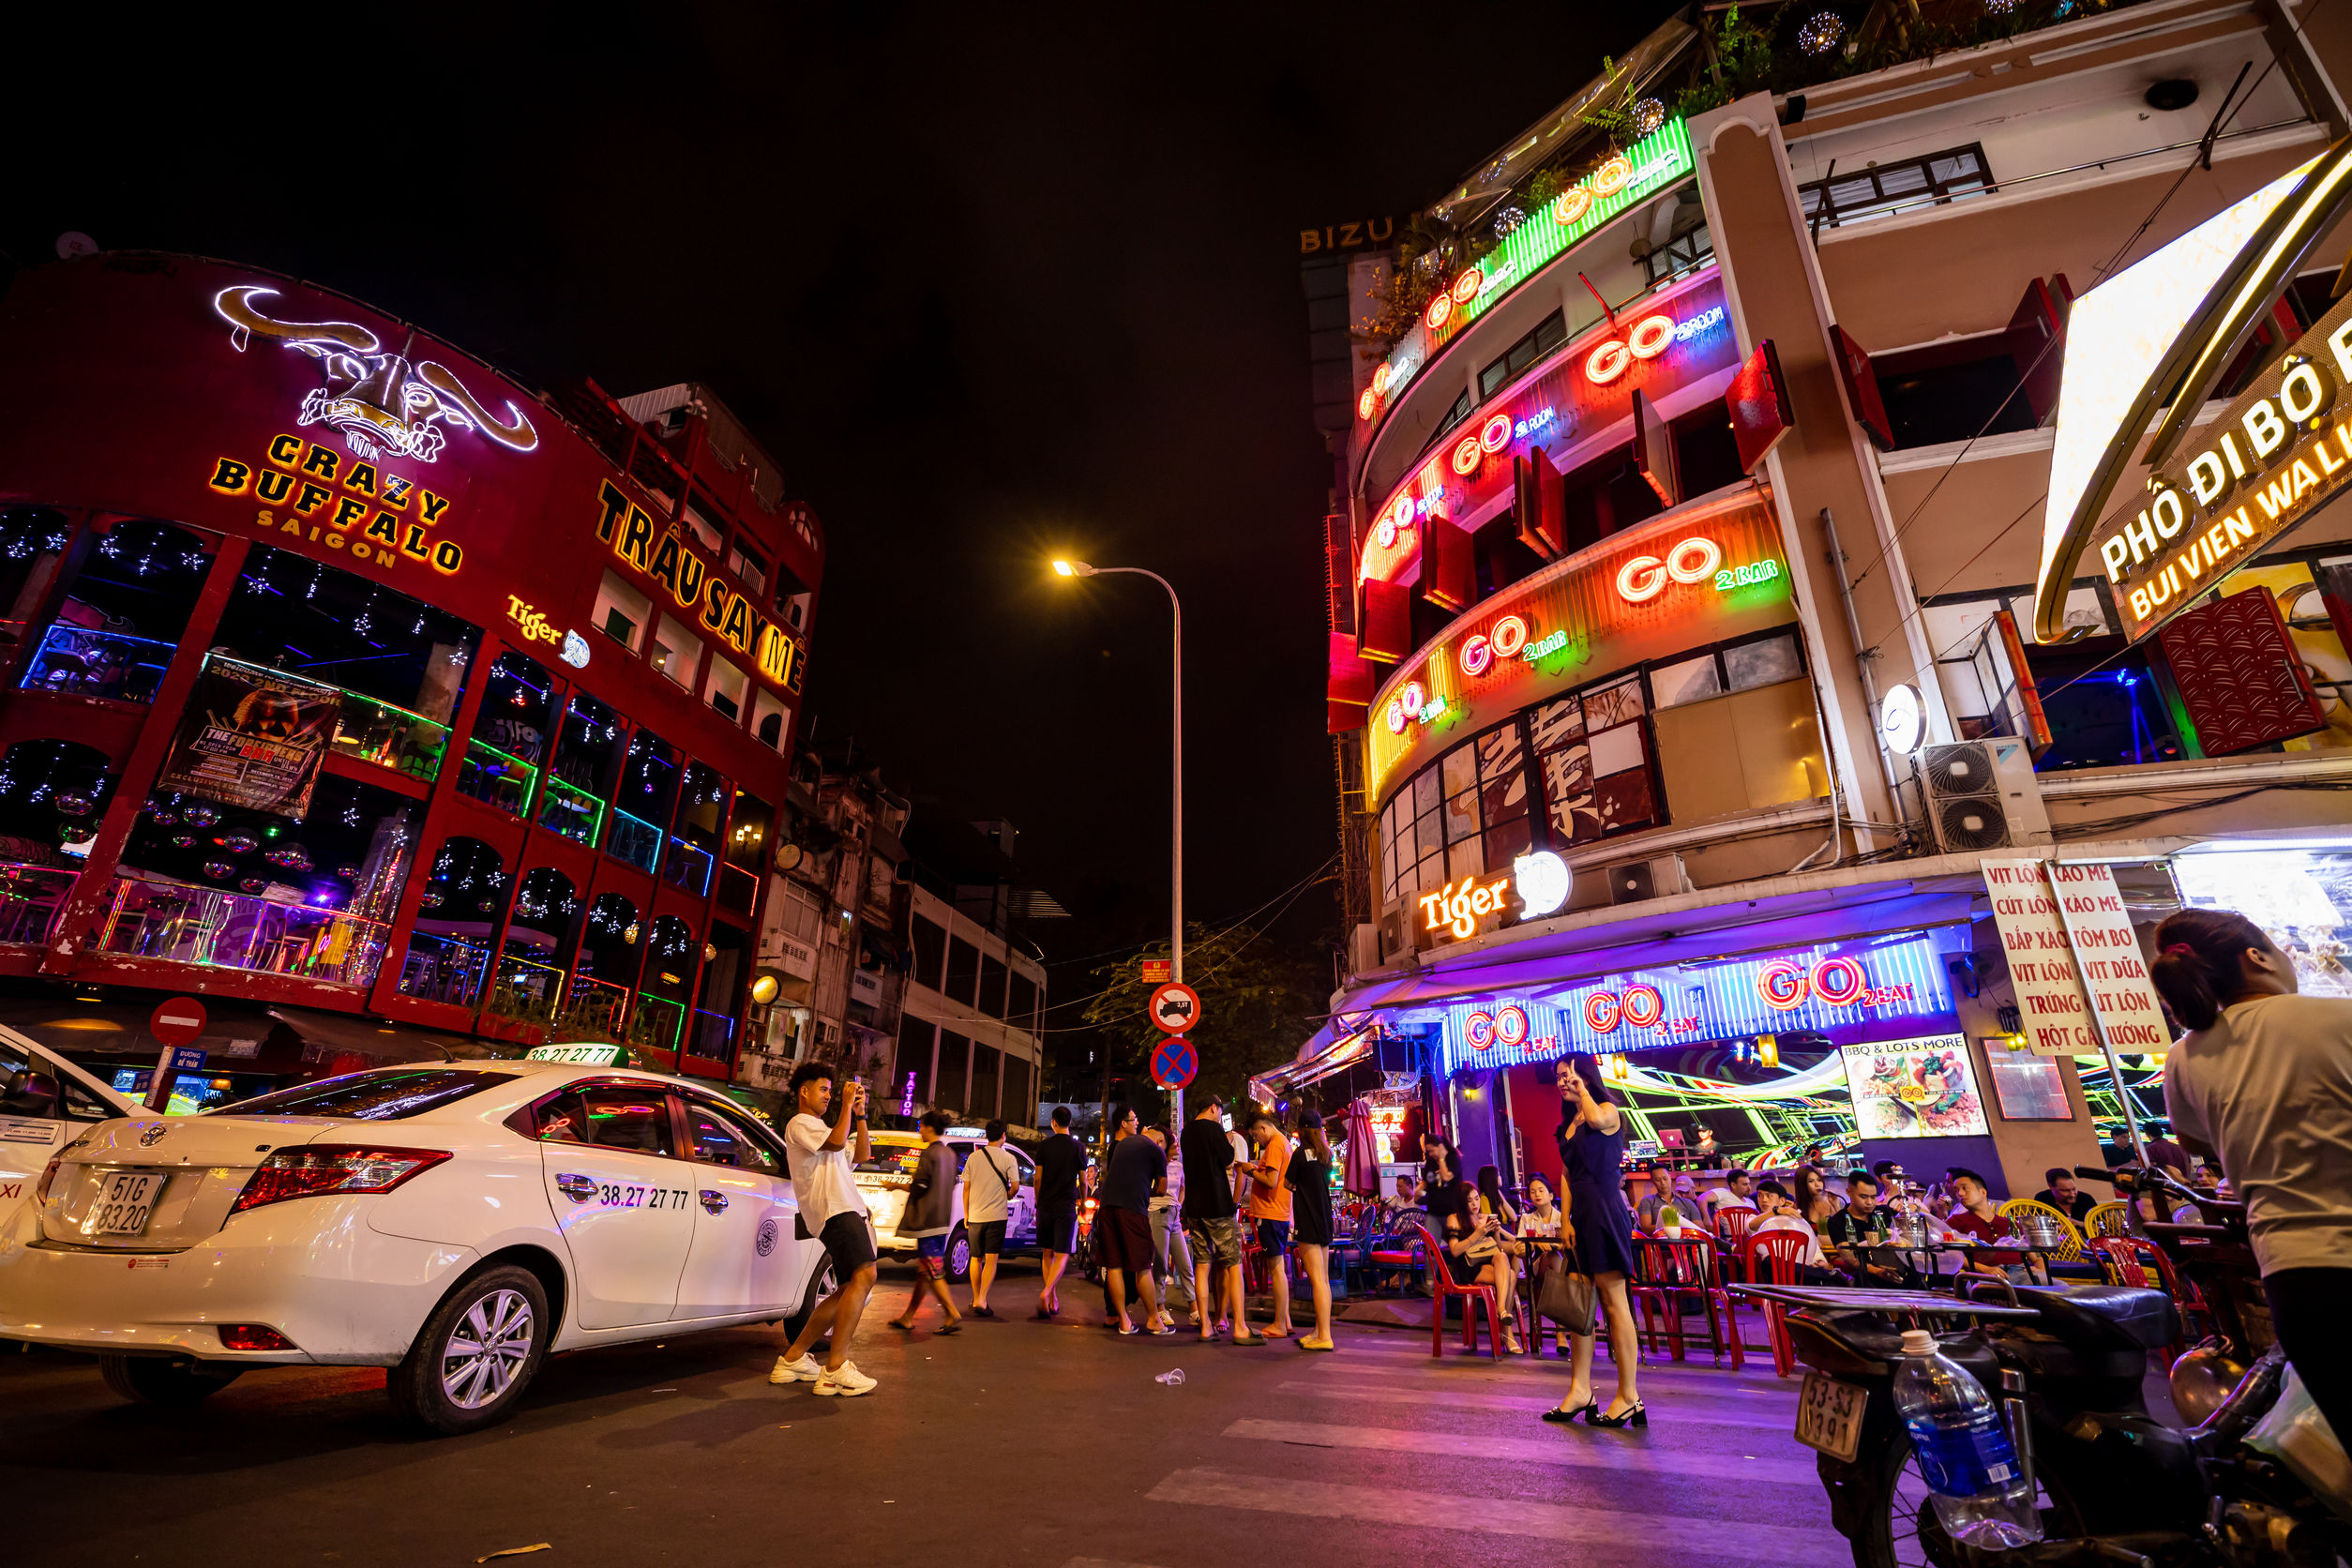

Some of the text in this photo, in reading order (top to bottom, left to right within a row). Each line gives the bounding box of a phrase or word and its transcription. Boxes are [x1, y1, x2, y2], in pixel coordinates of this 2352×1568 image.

[1554, 157, 1634, 225] GO
[1300, 216, 1395, 254] BIZU
[1586, 314, 1676, 384] GO
[1453, 414, 1512, 475] GO
[2187, 431, 2246, 507] ĐI
[2241, 354, 2323, 459] BỘ
[267, 433, 451, 526] CRAZY
[208, 456, 464, 577] BUFFALO
[256, 508, 398, 570] SAIGON
[595, 476, 807, 696] TRÂU SAY MÊ
[1616, 536, 1722, 602] GO
[2129, 567, 2180, 622] BUI
[2179, 505, 2254, 580] VIEN
[506, 594, 563, 646] Tiger
[1459, 615, 1529, 676] GO
[1387, 681, 1425, 735] GO
[206, 727, 232, 743] THE
[238, 744, 276, 764] BAR
[1987, 867, 2012, 887] VỊT
[2087, 864, 2110, 881] ME
[1419, 875, 1508, 940] Tiger
[1996, 896, 2024, 915] CÚT
[2062, 893, 2096, 913] XÀO
[2097, 896, 2122, 912] ME
[2005, 925, 2133, 950] BẮP XÀO TÔM BƠ
[1757, 956, 1867, 1011] GO
[2012, 963, 2036, 987] VỊT
[2040, 958, 2073, 986] LỘN
[2084, 961, 2108, 984] VỊT
[1465, 1005, 1528, 1051] GO
[1585, 983, 1665, 1034] GO
[2027, 990, 2082, 1015] TRỨNG
[2118, 988, 2151, 1017] LỘN
[531, 1048, 616, 1063] 38 27 27 77
[1844, 1036, 1964, 1056] BBQ & LOTS MORE
[2036, 1023, 2072, 1051] HỘT
[2074, 1021, 2100, 1047] GÀ
[902, 1071, 917, 1118] TATTOO
[111, 1176, 149, 1202] 51G
[648, 1187, 671, 1210] 27
[671, 1189, 689, 1211] 77
